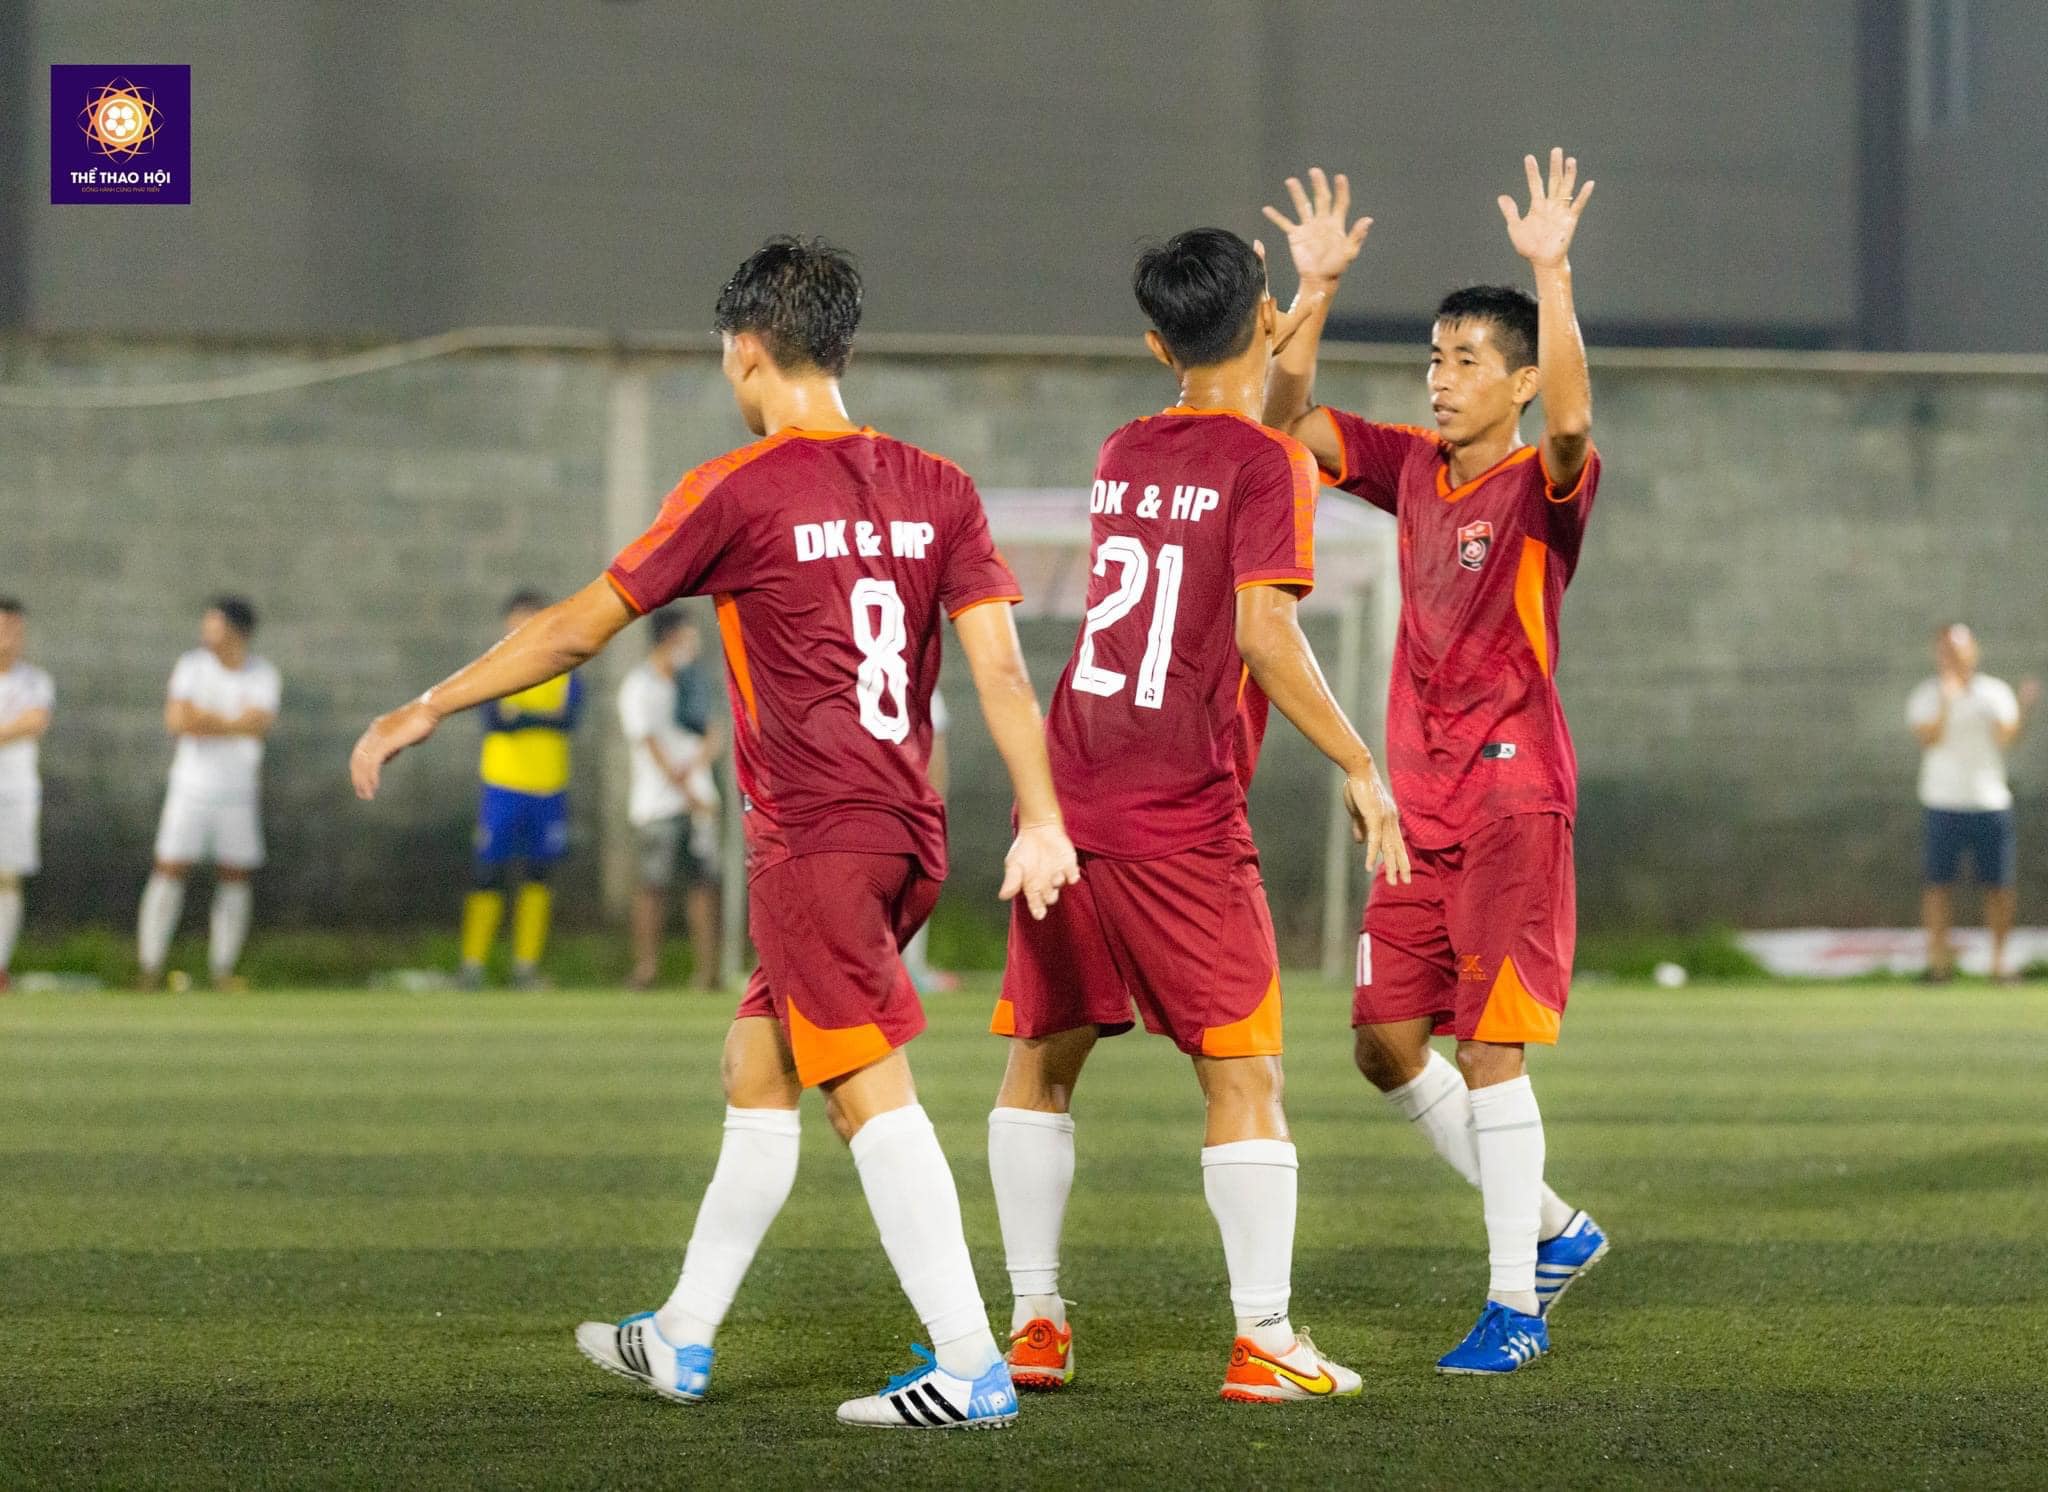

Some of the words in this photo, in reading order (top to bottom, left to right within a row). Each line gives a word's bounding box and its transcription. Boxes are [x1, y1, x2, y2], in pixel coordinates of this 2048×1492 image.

[794, 519, 850, 562] DK
[855, 520, 882, 557] &
[1136, 485, 1163, 519] &
[1170, 485, 1220, 522] HP
[850, 577, 910, 745] 8
[1071, 535, 1184, 710] 21
